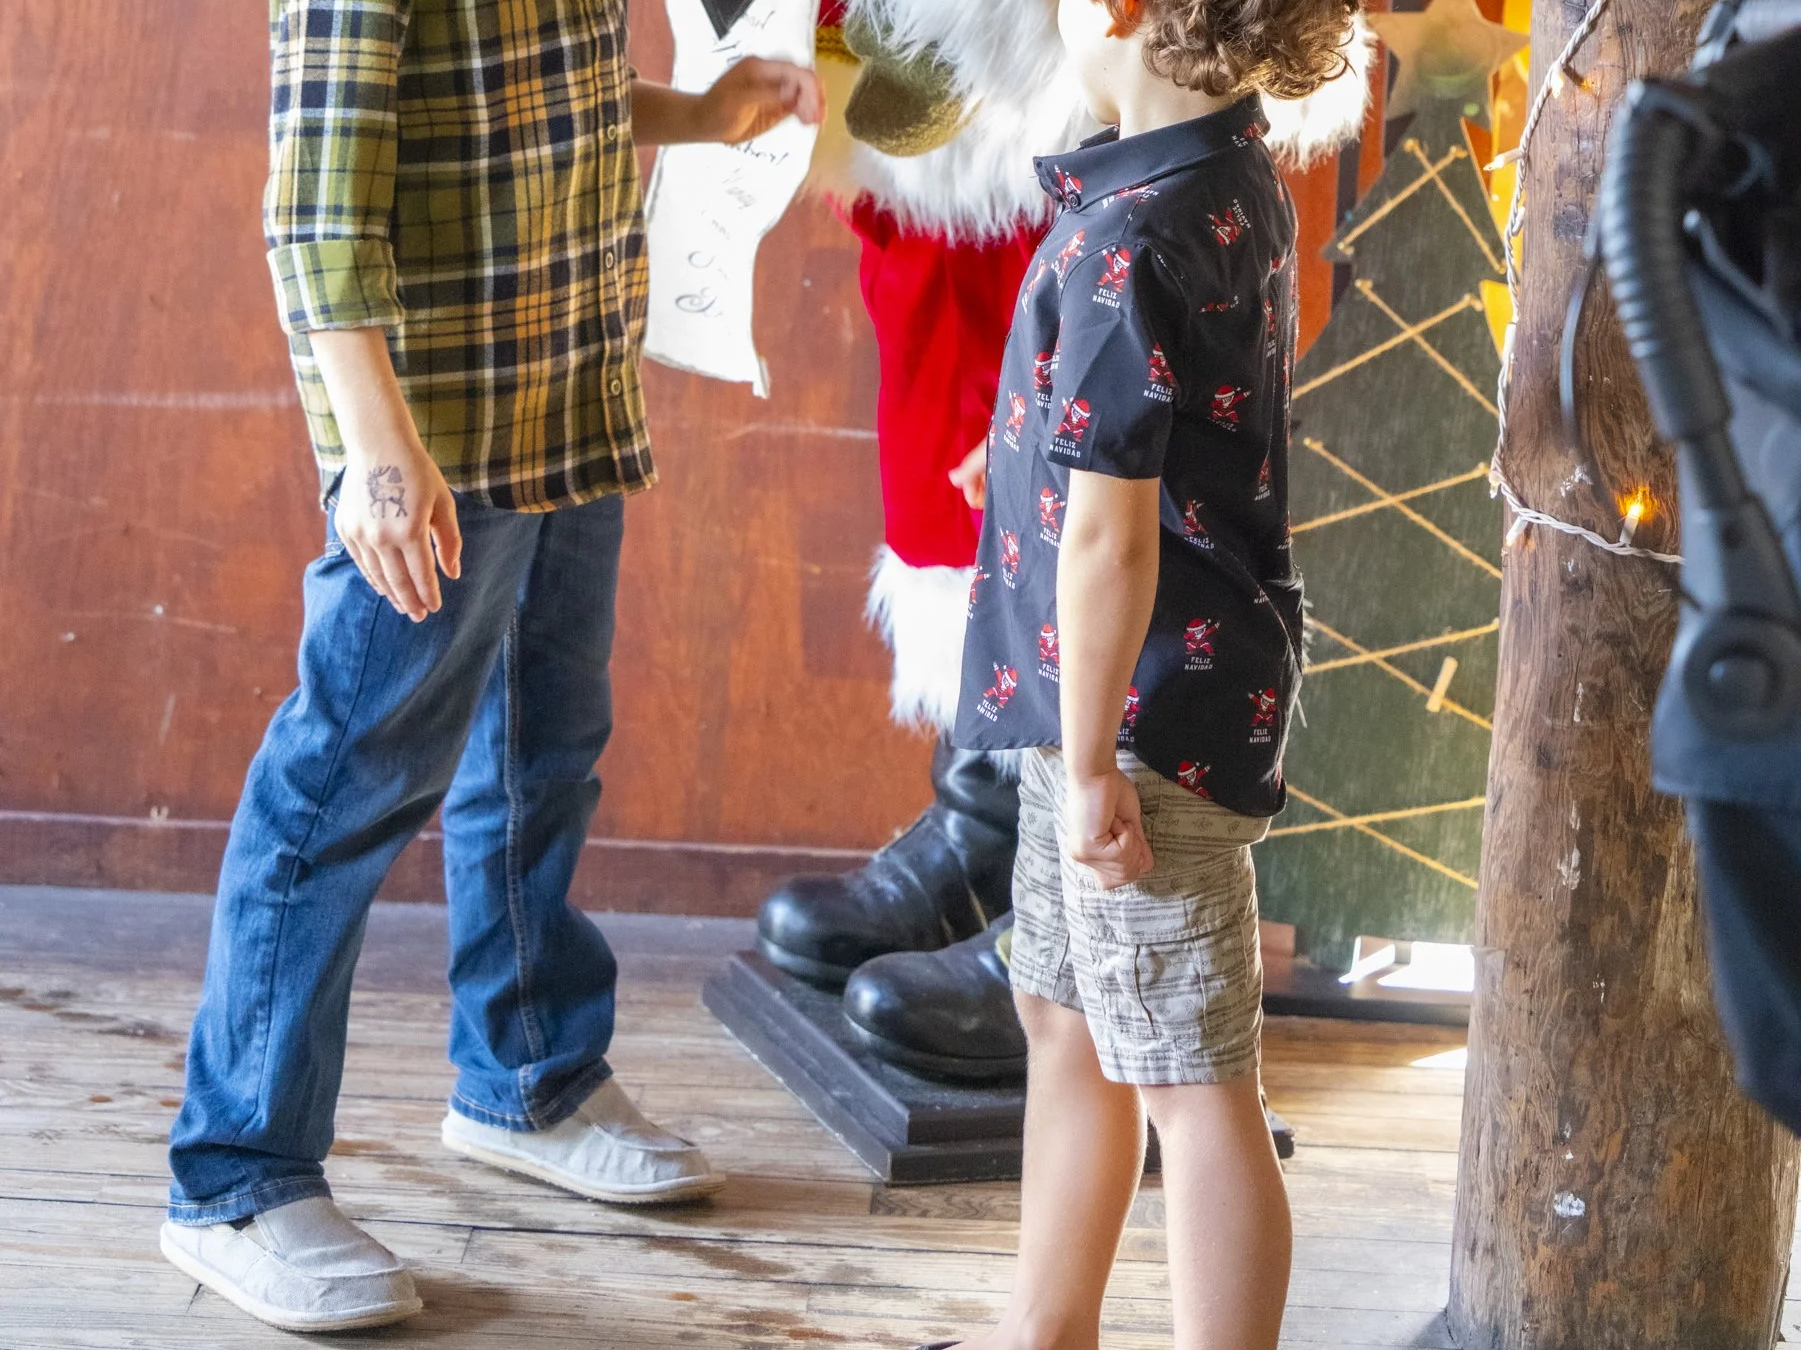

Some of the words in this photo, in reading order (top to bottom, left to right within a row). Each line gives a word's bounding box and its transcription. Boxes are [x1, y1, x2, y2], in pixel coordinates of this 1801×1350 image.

[1098, 287, 1118, 300] FELIZ
[1092, 294, 1121, 309] NAVIDAD
[1151, 383, 1173, 396] FELIZ
[1055, 437, 1076, 449] FELIZ
[1049, 443, 1081, 458] NAVIDAD
[1190, 656, 1211, 664] FELIZ
[1042, 663, 1060, 675] FELIZ
[1184, 663, 1213, 671] NAVIDAD
[1038, 668, 1060, 683] NAVIDA
[976, 703, 998, 722] NAVIDAD
[982, 699, 998, 713] FELIZ
[1253, 728, 1268, 736] FELIZ
[1250, 735, 1271, 744] NAVIDAD
